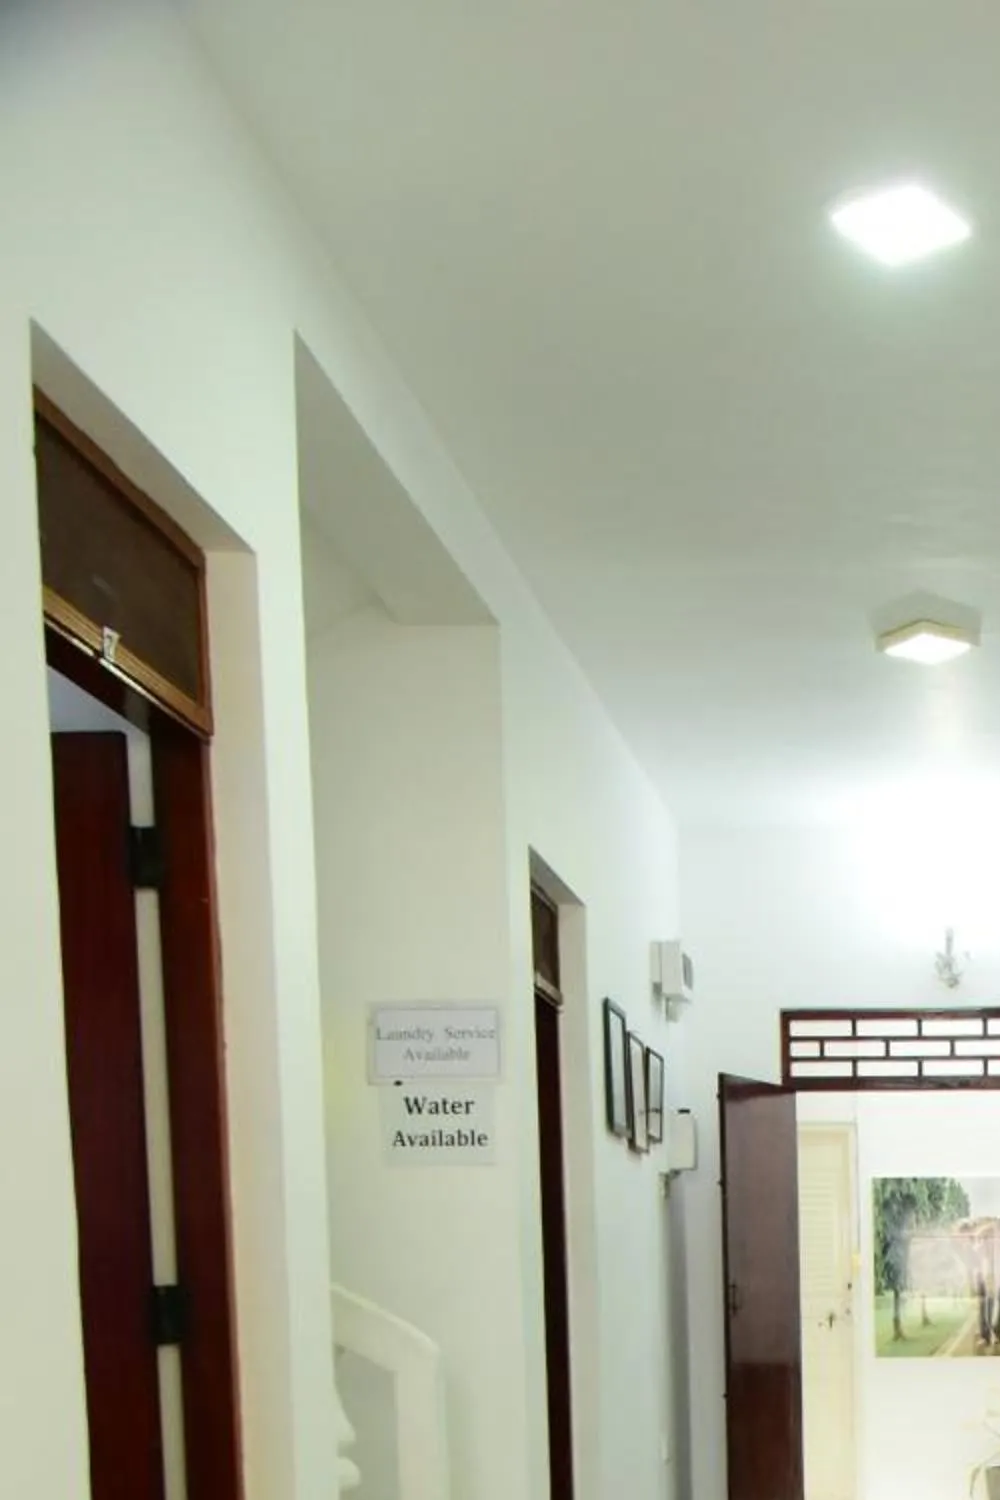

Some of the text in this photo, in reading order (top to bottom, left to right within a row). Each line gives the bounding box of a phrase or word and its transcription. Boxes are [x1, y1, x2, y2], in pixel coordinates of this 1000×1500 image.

[444, 1027, 496, 1040] Service
[403, 1048, 471, 1062] Available
[403, 1096, 475, 1115] Water
[392, 1129, 489, 1147] Available
